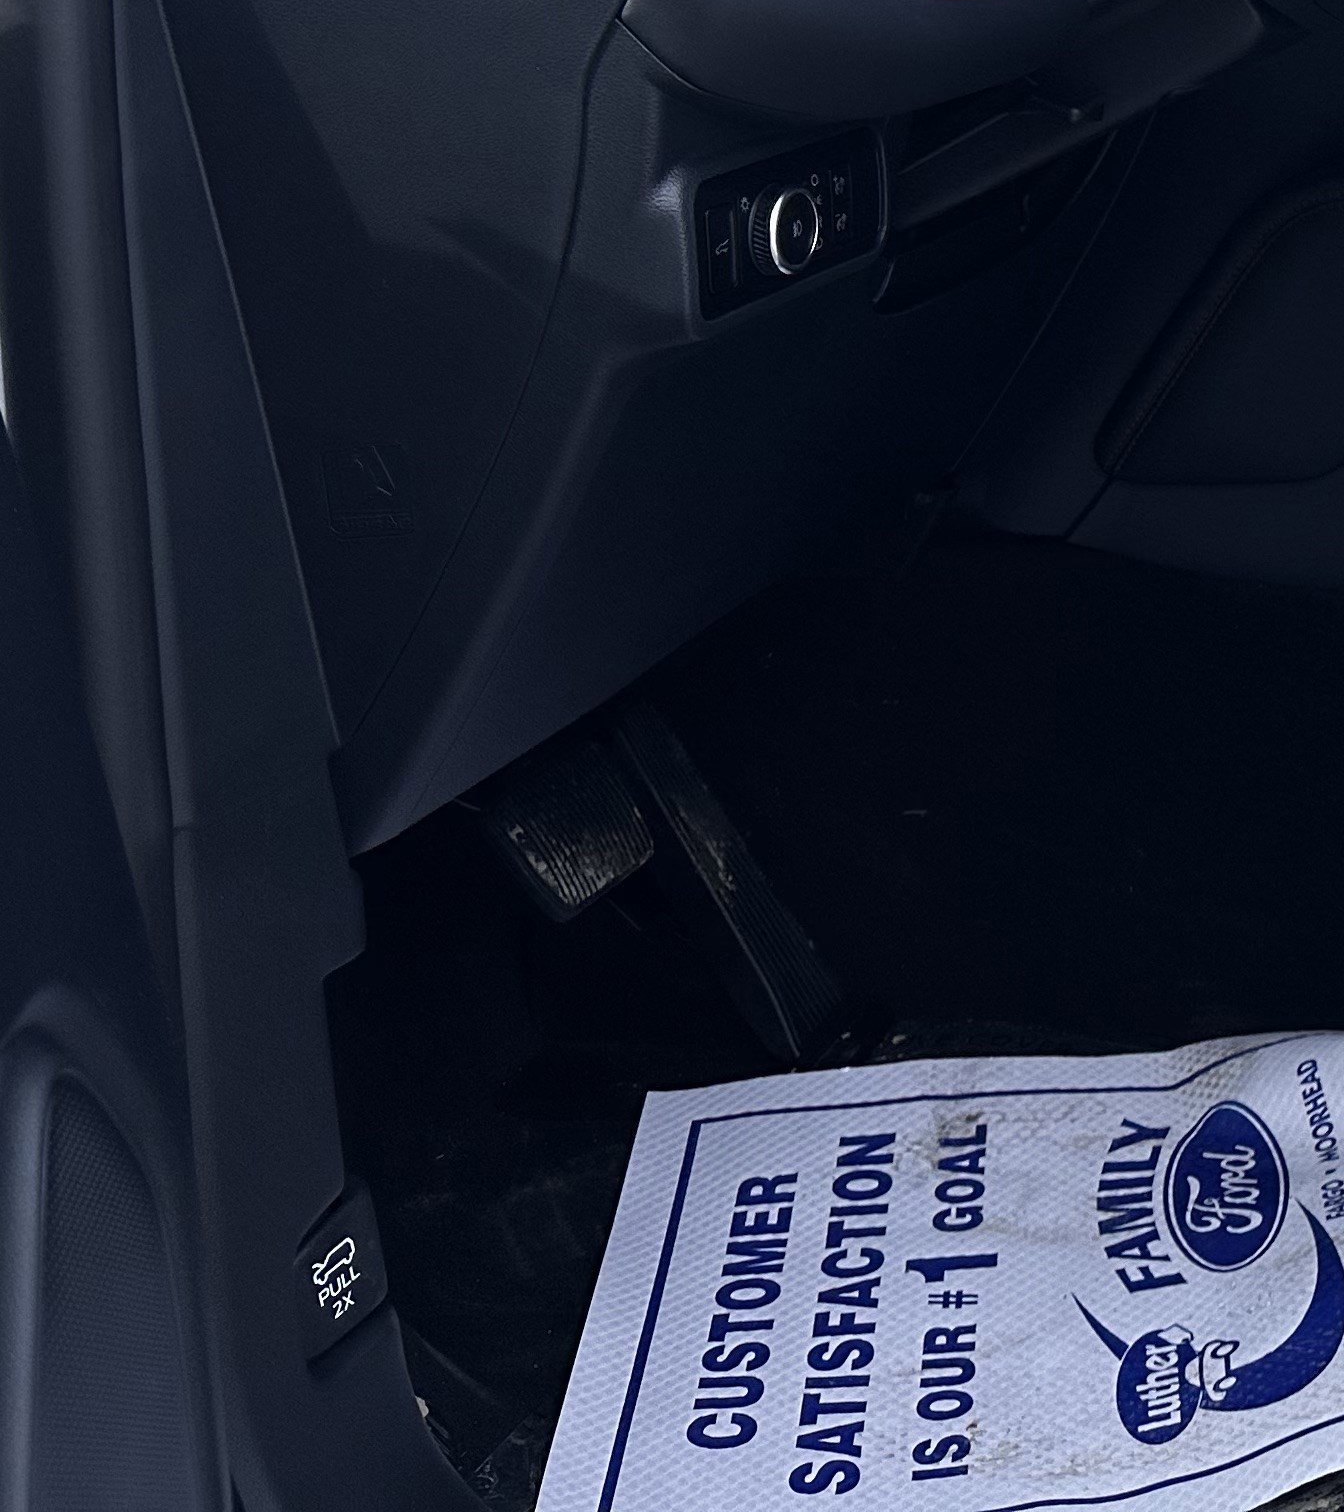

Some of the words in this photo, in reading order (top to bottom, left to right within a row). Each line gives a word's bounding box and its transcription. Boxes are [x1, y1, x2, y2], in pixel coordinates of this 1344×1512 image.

[1296, 1059, 1340, 1163] MOORHEAD
[932, 1124, 988, 1232] GOAL
[1096, 1118, 1188, 1294] FAMILY
[1186, 1144, 1264, 1234] Ford
[318, 1265, 361, 1308] PULL
[332, 1290, 355, 1320] 2X
[686, 1172, 799, 1450] CUSTOMER
[788, 1132, 897, 1495] SATISFACTION
[916, 1324, 977, 1421] OUR
[1136, 1344, 1182, 1433] Luther
[911, 1434, 972, 1481] IS
